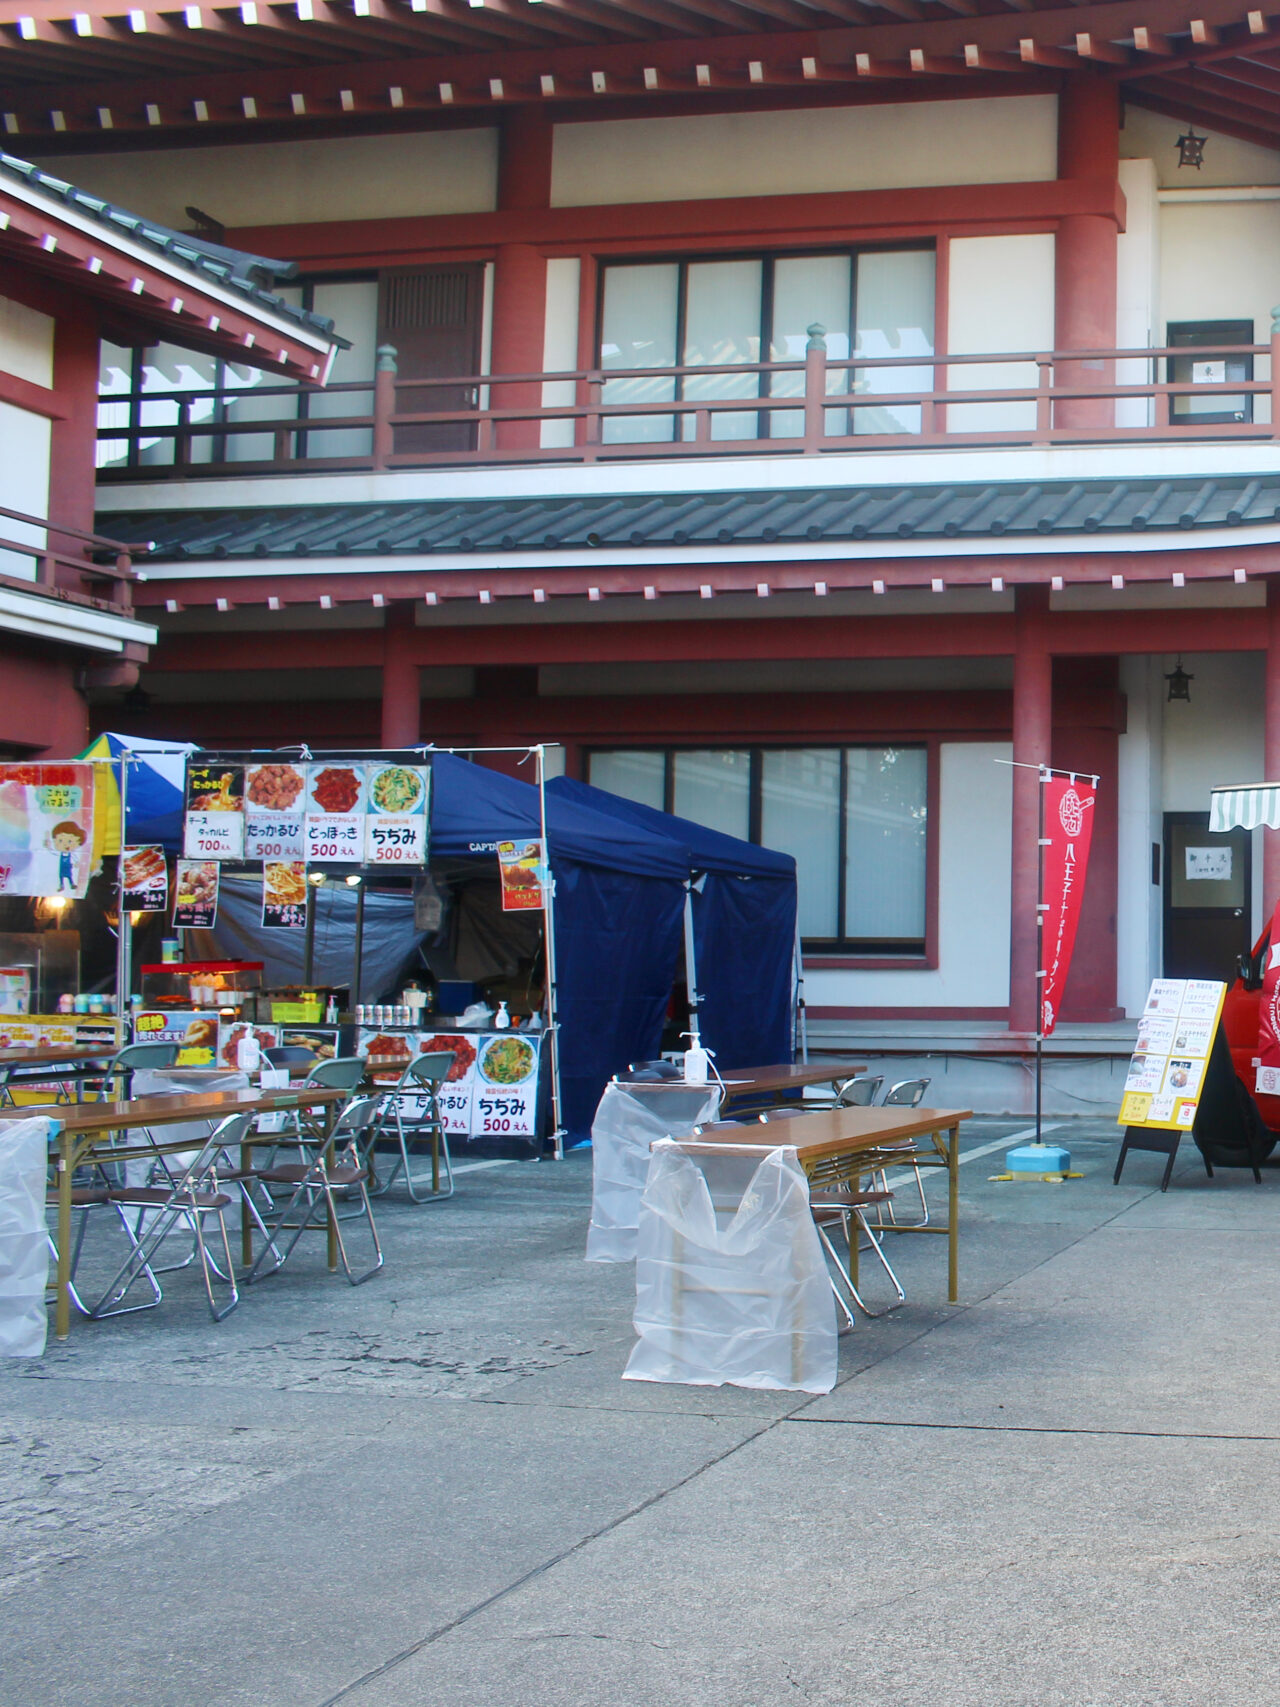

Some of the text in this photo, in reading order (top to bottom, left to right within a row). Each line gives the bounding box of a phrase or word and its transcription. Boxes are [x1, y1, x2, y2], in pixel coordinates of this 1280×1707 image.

[247, 824, 300, 837] たっかるび
[372, 827, 417, 845] ちぢみ
[479, 1098, 527, 1116] ちぢみ
